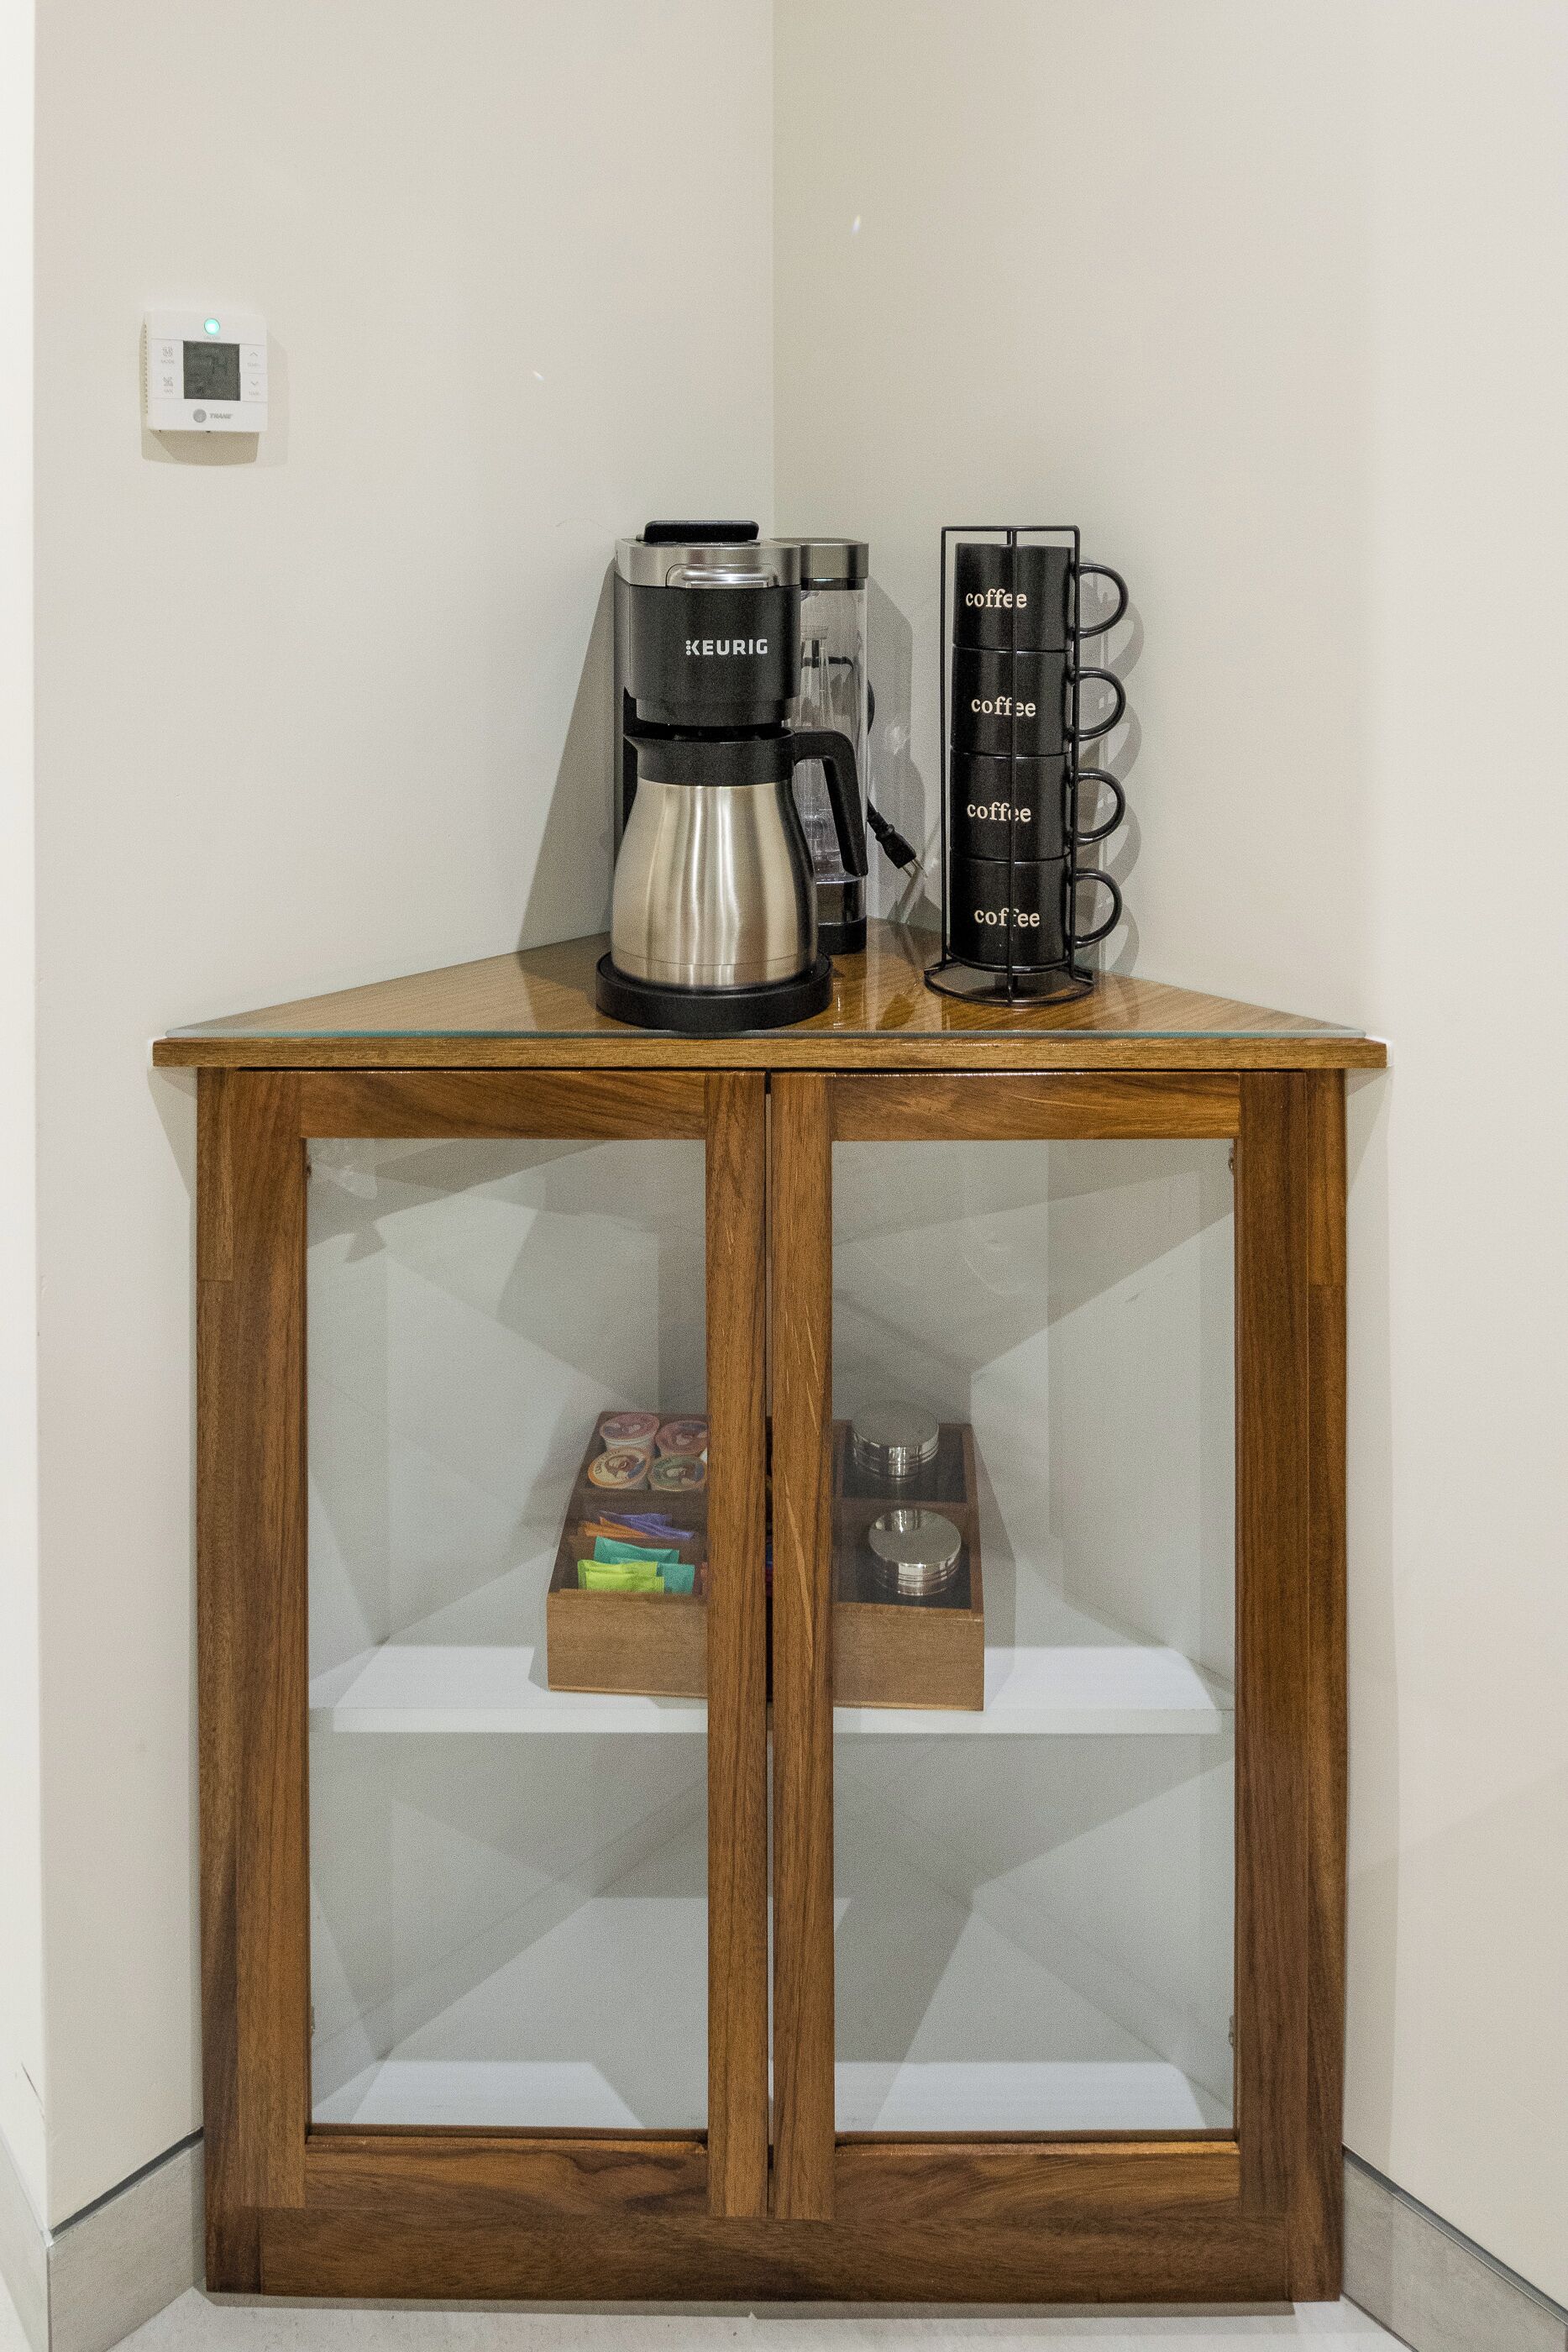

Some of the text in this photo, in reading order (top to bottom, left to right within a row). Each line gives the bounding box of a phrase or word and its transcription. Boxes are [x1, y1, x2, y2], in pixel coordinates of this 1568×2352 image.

[965, 588, 1027, 609] coffee
[685, 638, 768, 656] KEURIG
[971, 696, 1036, 717] coffee
